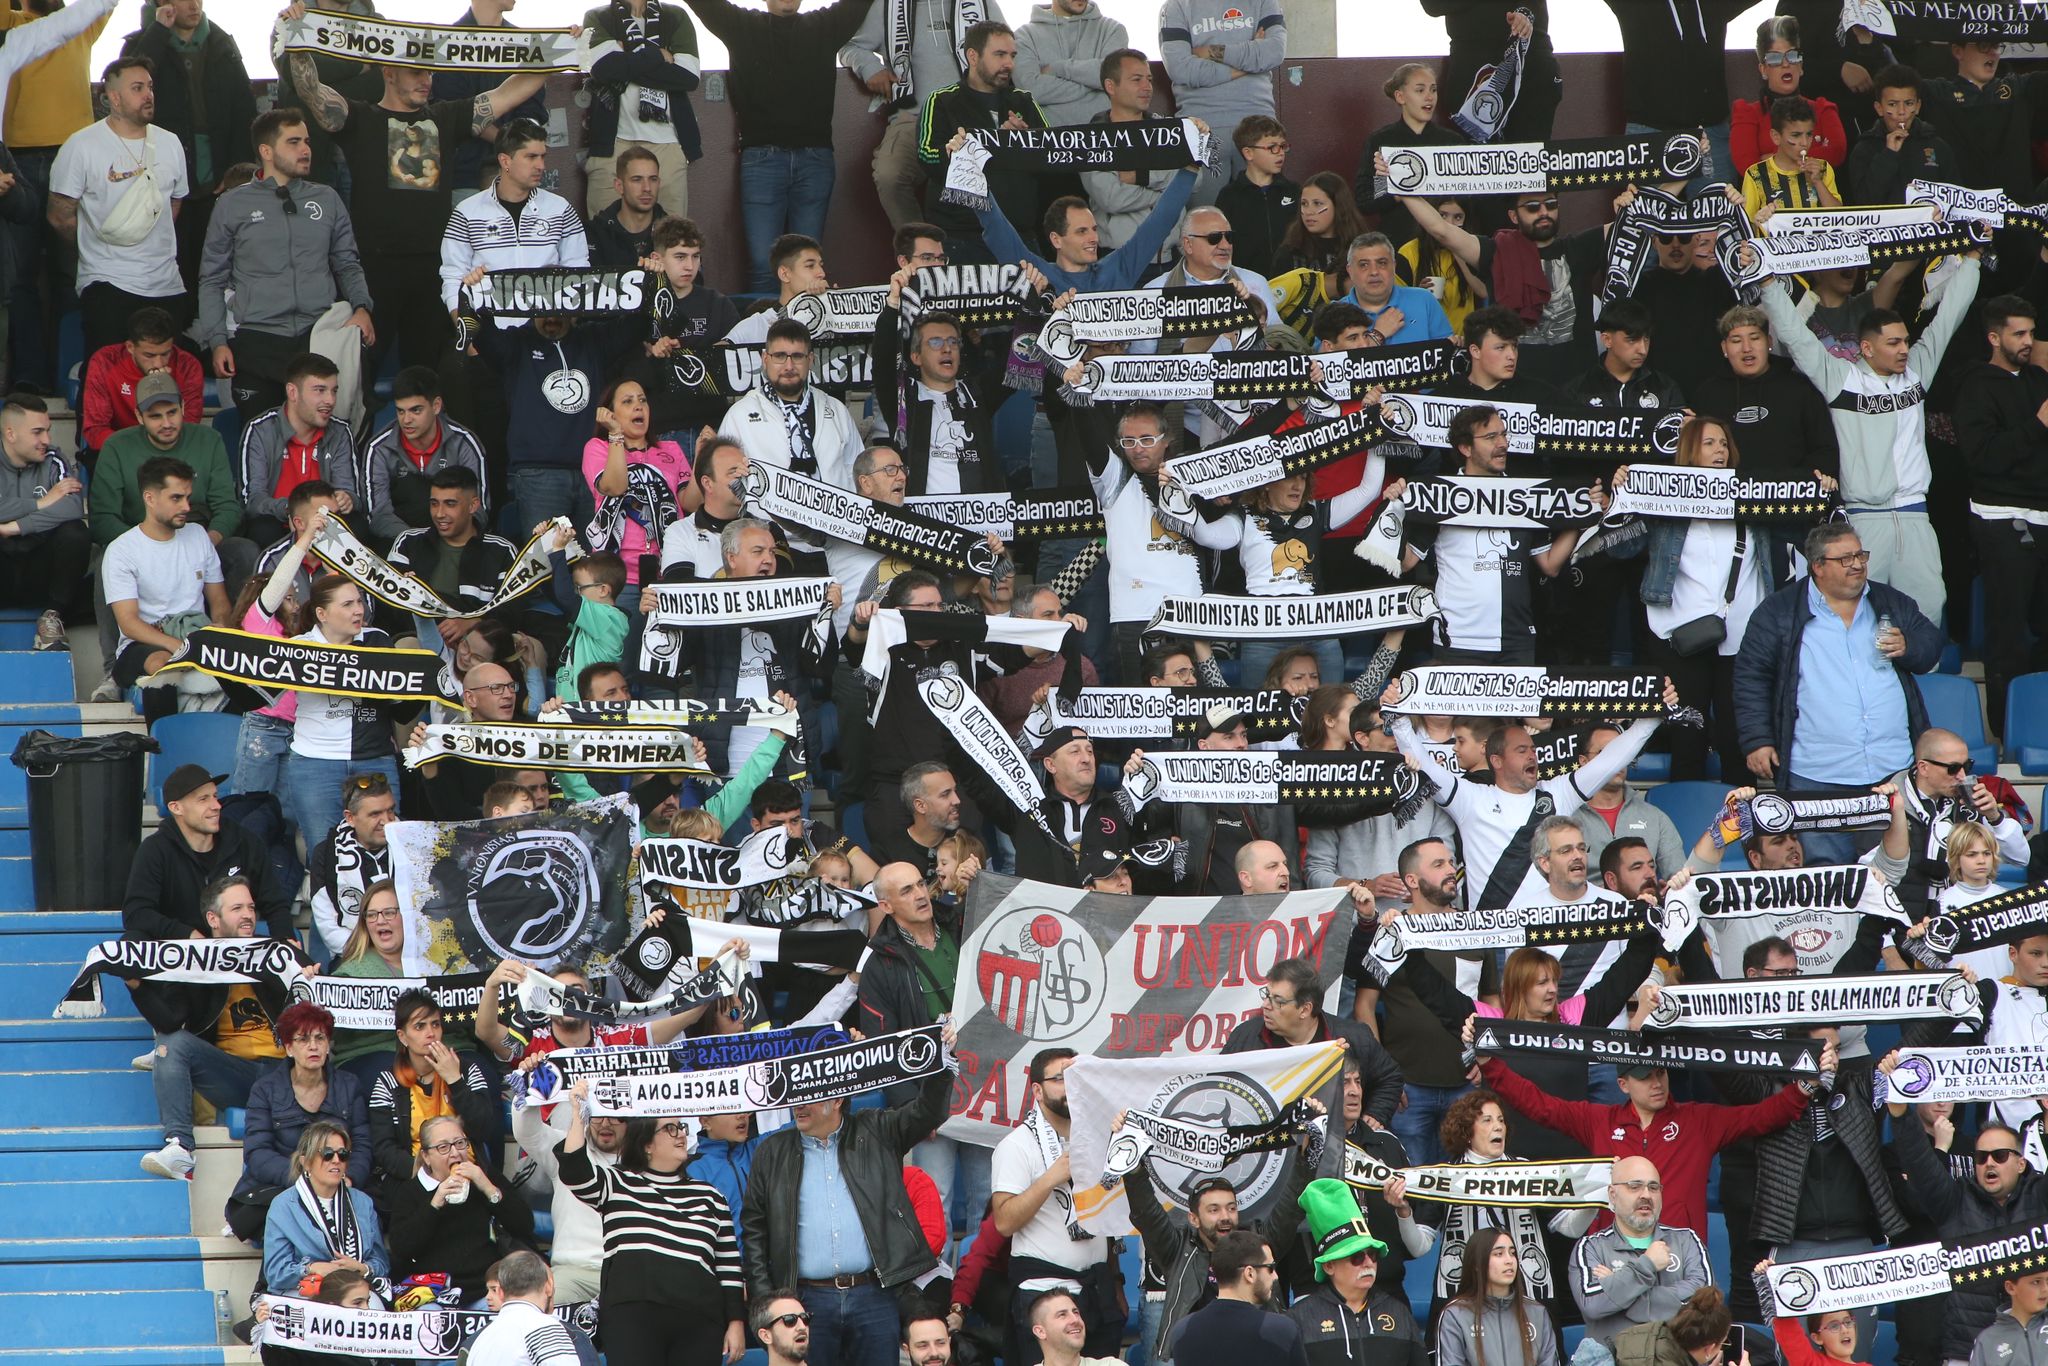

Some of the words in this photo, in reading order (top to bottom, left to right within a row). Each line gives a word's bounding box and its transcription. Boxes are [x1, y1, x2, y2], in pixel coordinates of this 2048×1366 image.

[1191, 16, 1255, 36] ellesse
[1962, 22, 1988, 34] 1923
[2003, 23, 2029, 34] 2013
[405, 39, 435, 60] DE
[1140, 126, 1181, 148] VDS
[1046, 151, 1074, 164] 1923
[1086, 150, 1114, 164] 2013
[1433, 150, 1519, 176] UNIONISTAS
[1520, 153, 1538, 173] de
[1539, 147, 1626, 173] Salamanca
[1627, 142, 1654, 167] C.F.
[1487, 181, 1504, 191] VDS
[1978, 197, 1996, 213] de
[1765, 233, 1844, 256] UNIONISTAS
[1844, 231, 1860, 246] de
[1861, 222, 1935, 245] Salamanca
[463, 269, 646, 312] UNIONISTAS
[1139, 296, 1157, 317] de
[1157, 294, 1232, 318] Salamanca
[1111, 359, 1190, 385] UNIONISTAS
[1190, 360, 1209, 380] de
[1209, 356, 1288, 380] Salamanca
[1324, 358, 1343, 382] de
[1344, 354, 1419, 381] Salamanca
[1422, 347, 1443, 372] C.F.
[1158, 387, 1173, 396] VDS
[1510, 415, 1530, 435] de
[1530, 410, 1617, 438] Salamanca
[1619, 414, 1644, 439] C.F.
[1175, 448, 1254, 485] UNIONISTAS
[1254, 446, 1273, 468] de
[1272, 418, 1349, 461] Salamanca
[1349, 408, 1373, 435] C.F.
[1625, 471, 1708, 499] UNIONISTAS
[1708, 474, 1729, 498] de
[1729, 476, 1816, 500] Salamanca
[987, 501, 1006, 523] de
[1006, 498, 1094, 522] Salamanca
[1402, 480, 1593, 518] UNIONISTAS
[1673, 504, 1690, 515] VDS
[775, 473, 845, 519] UNIONISTAS
[846, 502, 863, 524] de
[863, 509, 939, 547] Salamanca
[938, 531, 962, 555] C.F.
[814, 518, 829, 531] VDS
[724, 590, 742, 613] DE
[748, 581, 828, 611] SALAMANCA
[1175, 600, 1259, 627] UNIONISTAS
[1264, 607, 1282, 627] DE
[1287, 599, 1375, 625] SALAMANCA
[1379, 594, 1395, 617] CF
[268, 643, 359, 667] UNIONISTAS
[200, 644, 297, 682] NUNCA
[301, 664, 338, 686] SE
[342, 667, 424, 693] RINDE
[1426, 671, 1515, 697] UNIONISTAS
[1516, 673, 1536, 698] de
[1537, 675, 1629, 699] Salamanca
[1631, 676, 1660, 699] C.F.
[1144, 694, 1165, 717] de
[1256, 690, 1283, 713] C.F.
[1476, 703, 1493, 713] VDS
[1110, 724, 1127, 734] VDS
[538, 741, 569, 760] DE
[960, 706, 1026, 783] UNIONISTAS
[1166, 758, 1251, 783] UNIONISTAS
[1252, 759, 1272, 782] de
[1272, 760, 1358, 783] Salamanca
[1359, 759, 1385, 782] C.F.
[1219, 790, 1236, 800] VDS
[1791, 794, 1890, 816] UNIONISTAS
[1404, 908, 1495, 933] UNIONISTAS
[1496, 907, 1518, 928] de
[1519, 901, 1608, 927] Salamanca
[1132, 911, 1336, 990] UNION
[1462, 935, 1480, 945] VDS
[98, 941, 294, 974] UNIONISTAS
[315, 982, 400, 1010] UNIONISTAS
[1690, 990, 1781, 1016] UNIONISTAS
[1787, 991, 1806, 1011] DE
[1811, 986, 1901, 1012] SALAMANCA
[1906, 984, 1925, 1007] CF
[1508, 1032, 1585, 1051] UNIÓN
[1592, 1040, 1654, 1058] SOLO
[1660, 1044, 1728, 1064] HUBO
[1734, 1050, 1784, 1067] UNA
[1966, 1048, 1992, 1056] COPA
[2020, 1045, 2032, 1053] M.
[1932, 1090, 1965, 1099] ESTADIO
[1968, 1088, 2007, 1098] MUNICIPAL
[1944, 1077, 1961, 1088] DE
[1965, 1074, 2046, 1087] SALAMANCA
[1198, 1134, 1218, 1155] de
[1418, 1174, 1451, 1192] DE
[1824, 1254, 1916, 1291] UNIONISTAS
[1919, 1252, 1939, 1275] de
[1939, 1233, 2031, 1273] Salamanca
[1882, 1287, 1903, 1300] VDS
